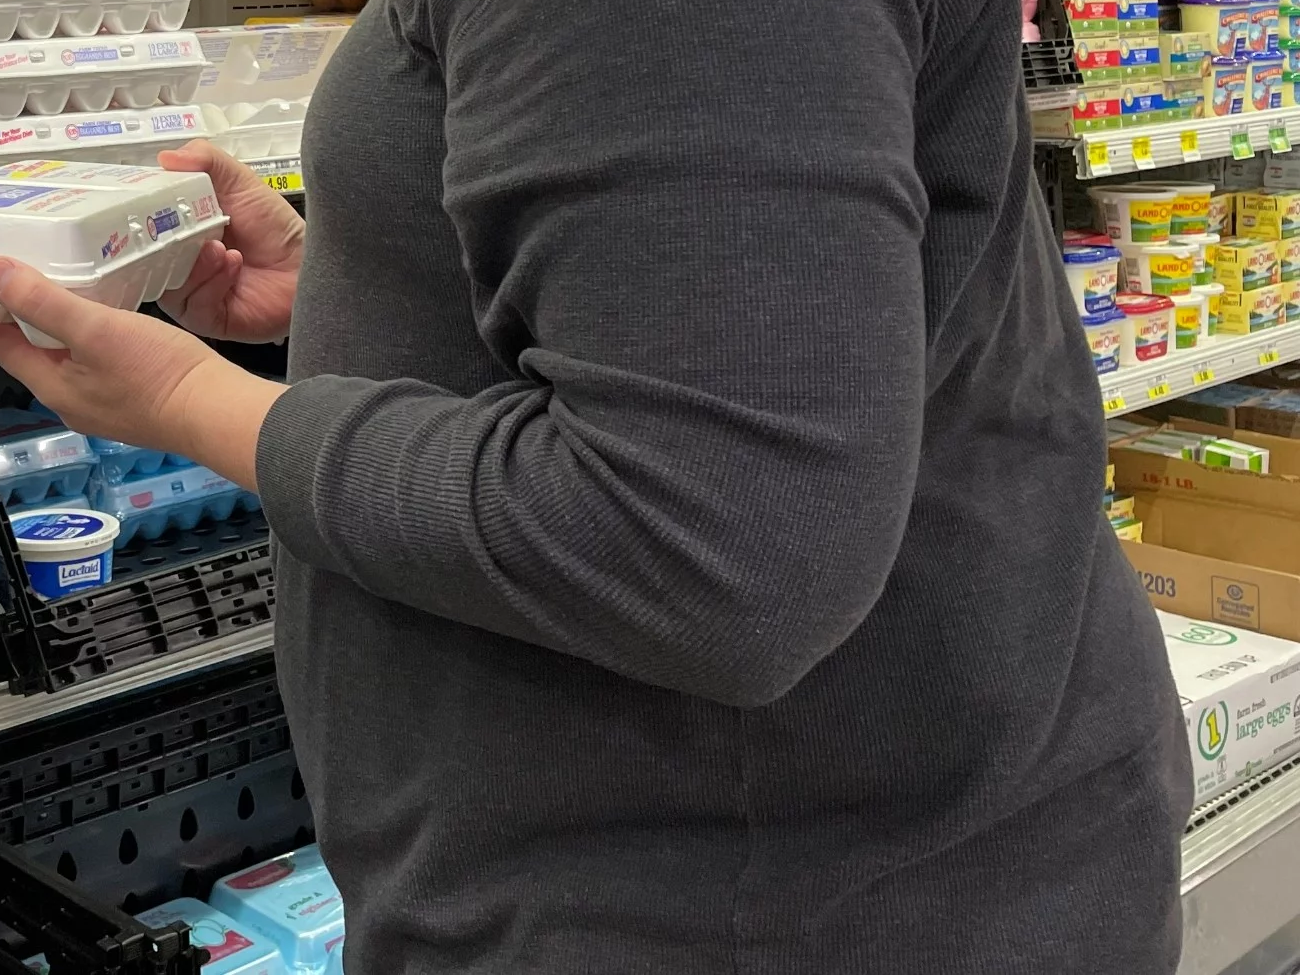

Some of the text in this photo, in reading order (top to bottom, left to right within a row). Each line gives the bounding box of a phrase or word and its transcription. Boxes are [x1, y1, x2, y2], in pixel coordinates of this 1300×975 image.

[268, 176, 288, 191] 4.98
[1137, 209, 1158, 217] LAND
[1157, 264, 1179, 272] LAND
[61, 562, 99, 579] Lactaid
[1237, 698, 1266, 720] farm fresh
[1236, 701, 1291, 741] large eggs
